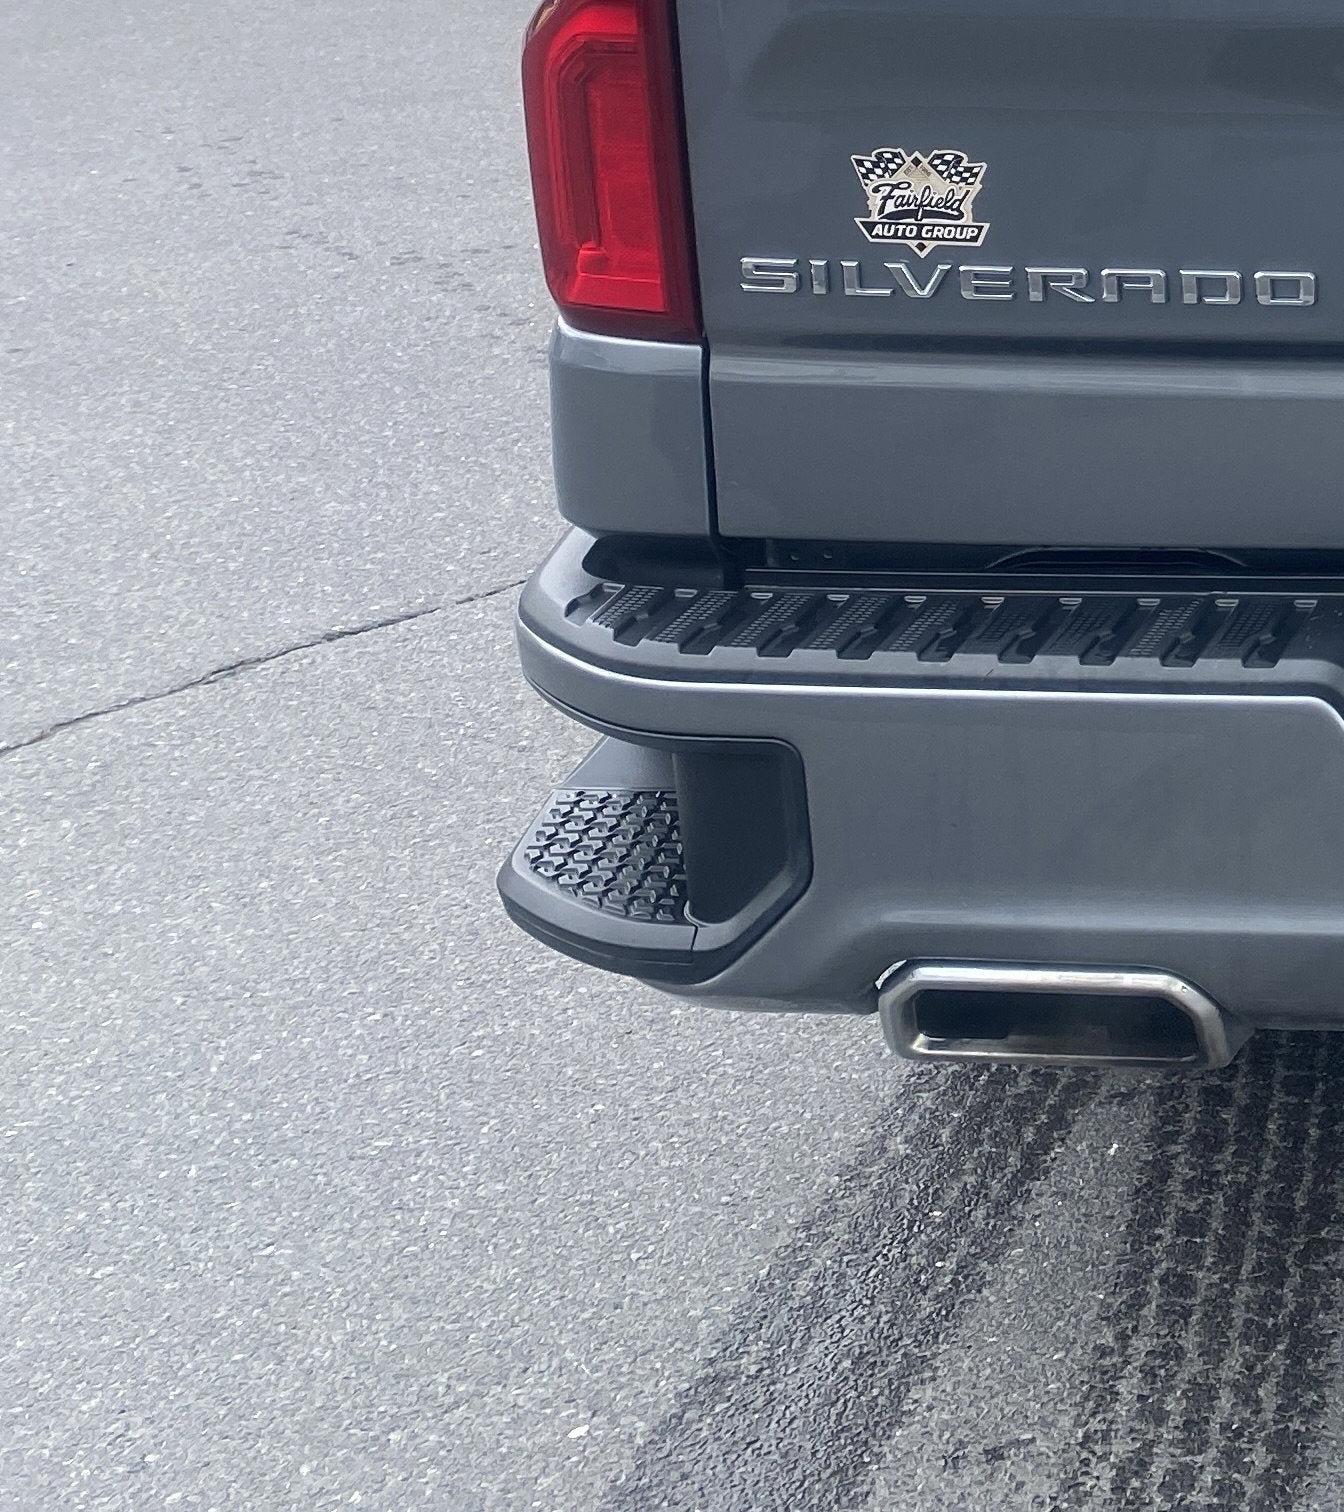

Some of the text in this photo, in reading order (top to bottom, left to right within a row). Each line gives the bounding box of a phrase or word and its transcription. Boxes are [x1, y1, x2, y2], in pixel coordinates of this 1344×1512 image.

[870, 181, 972, 221] Fairfield
[871, 223, 979, 240] AUTO GROUP
[740, 257, 1319, 306] SILVERADO
